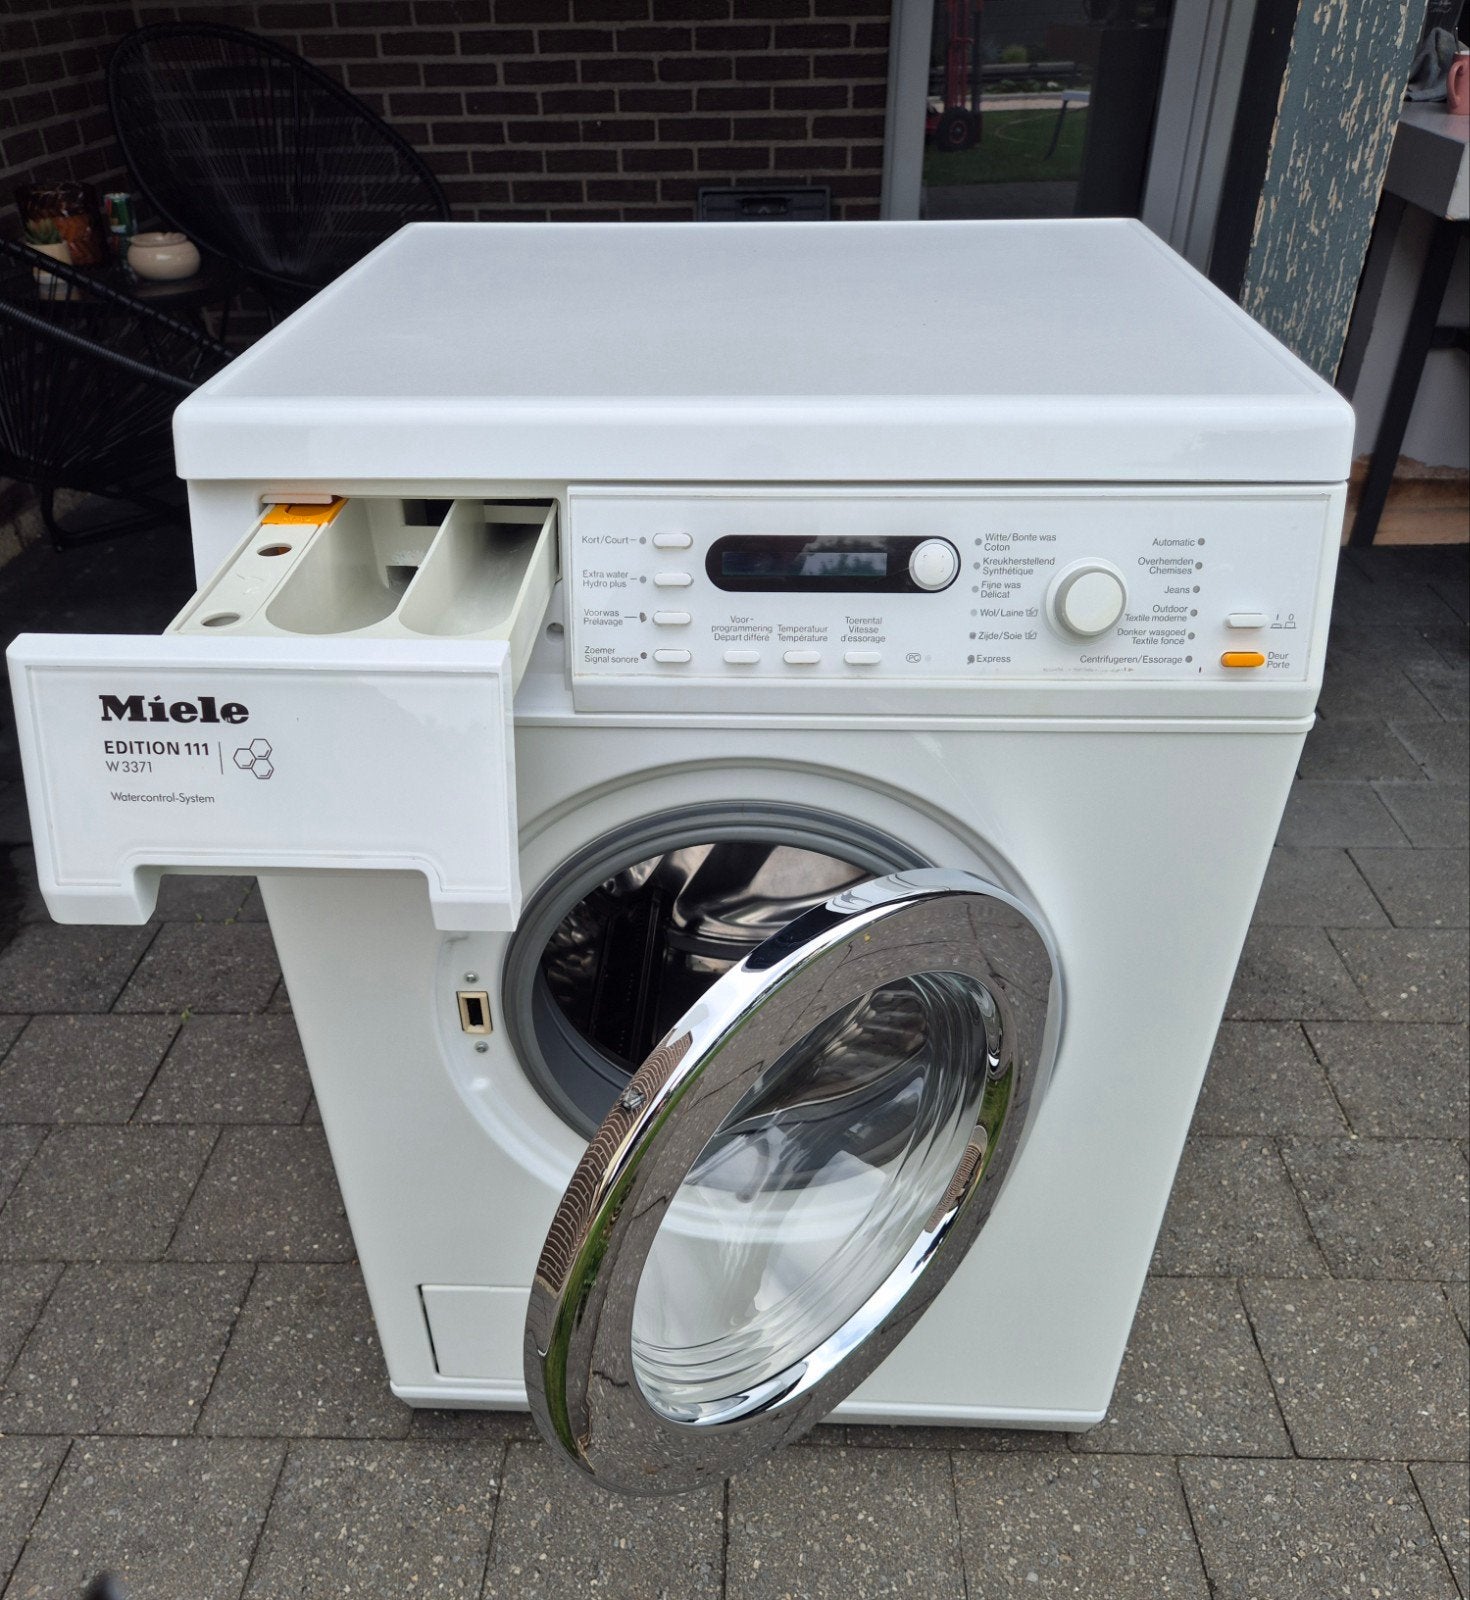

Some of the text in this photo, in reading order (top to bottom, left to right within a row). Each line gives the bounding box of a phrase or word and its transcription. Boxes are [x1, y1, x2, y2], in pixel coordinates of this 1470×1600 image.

[1152, 538, 1196, 546] Automatic
[984, 542, 1010, 552] Coton
[982, 557, 1056, 566] Kreukherstellend
[1138, 556, 1194, 566] Overhemden
[582, 570, 628, 578] Extra water
[982, 566, 1034, 576] Synthétique
[1149, 566, 1192, 575] Chemises
[582, 580, 627, 589] Hydro plus
[981, 580, 1002, 589] Fijne
[1164, 586, 1190, 594] Jeans
[583, 608, 620, 617] Voorwas
[1152, 604, 1188, 613] Outdoor
[730, 615, 754, 624] Voor-
[845, 616, 883, 624] Toerental
[1125, 613, 1188, 622] Textile moderne
[711, 624, 773, 634] programmering
[777, 624, 830, 633] Temperatuur
[848, 626, 880, 634] Vitesse
[1117, 628, 1186, 638] Donker wasgoed
[777, 632, 828, 642] Température
[1132, 636, 1158, 645] Textile
[584, 646, 616, 654] Zoemer
[584, 654, 639, 664] Signal sonore
[976, 654, 1012, 664] Express
[1080, 654, 1183, 665] Centrifugeren/Essorage
[1268, 652, 1289, 660] Deur
[1266, 660, 1290, 669] Porte
[99, 695, 250, 724] Miele
[104, 740, 210, 756] EDITION 111
[111, 792, 215, 805] Watercontrol-System
